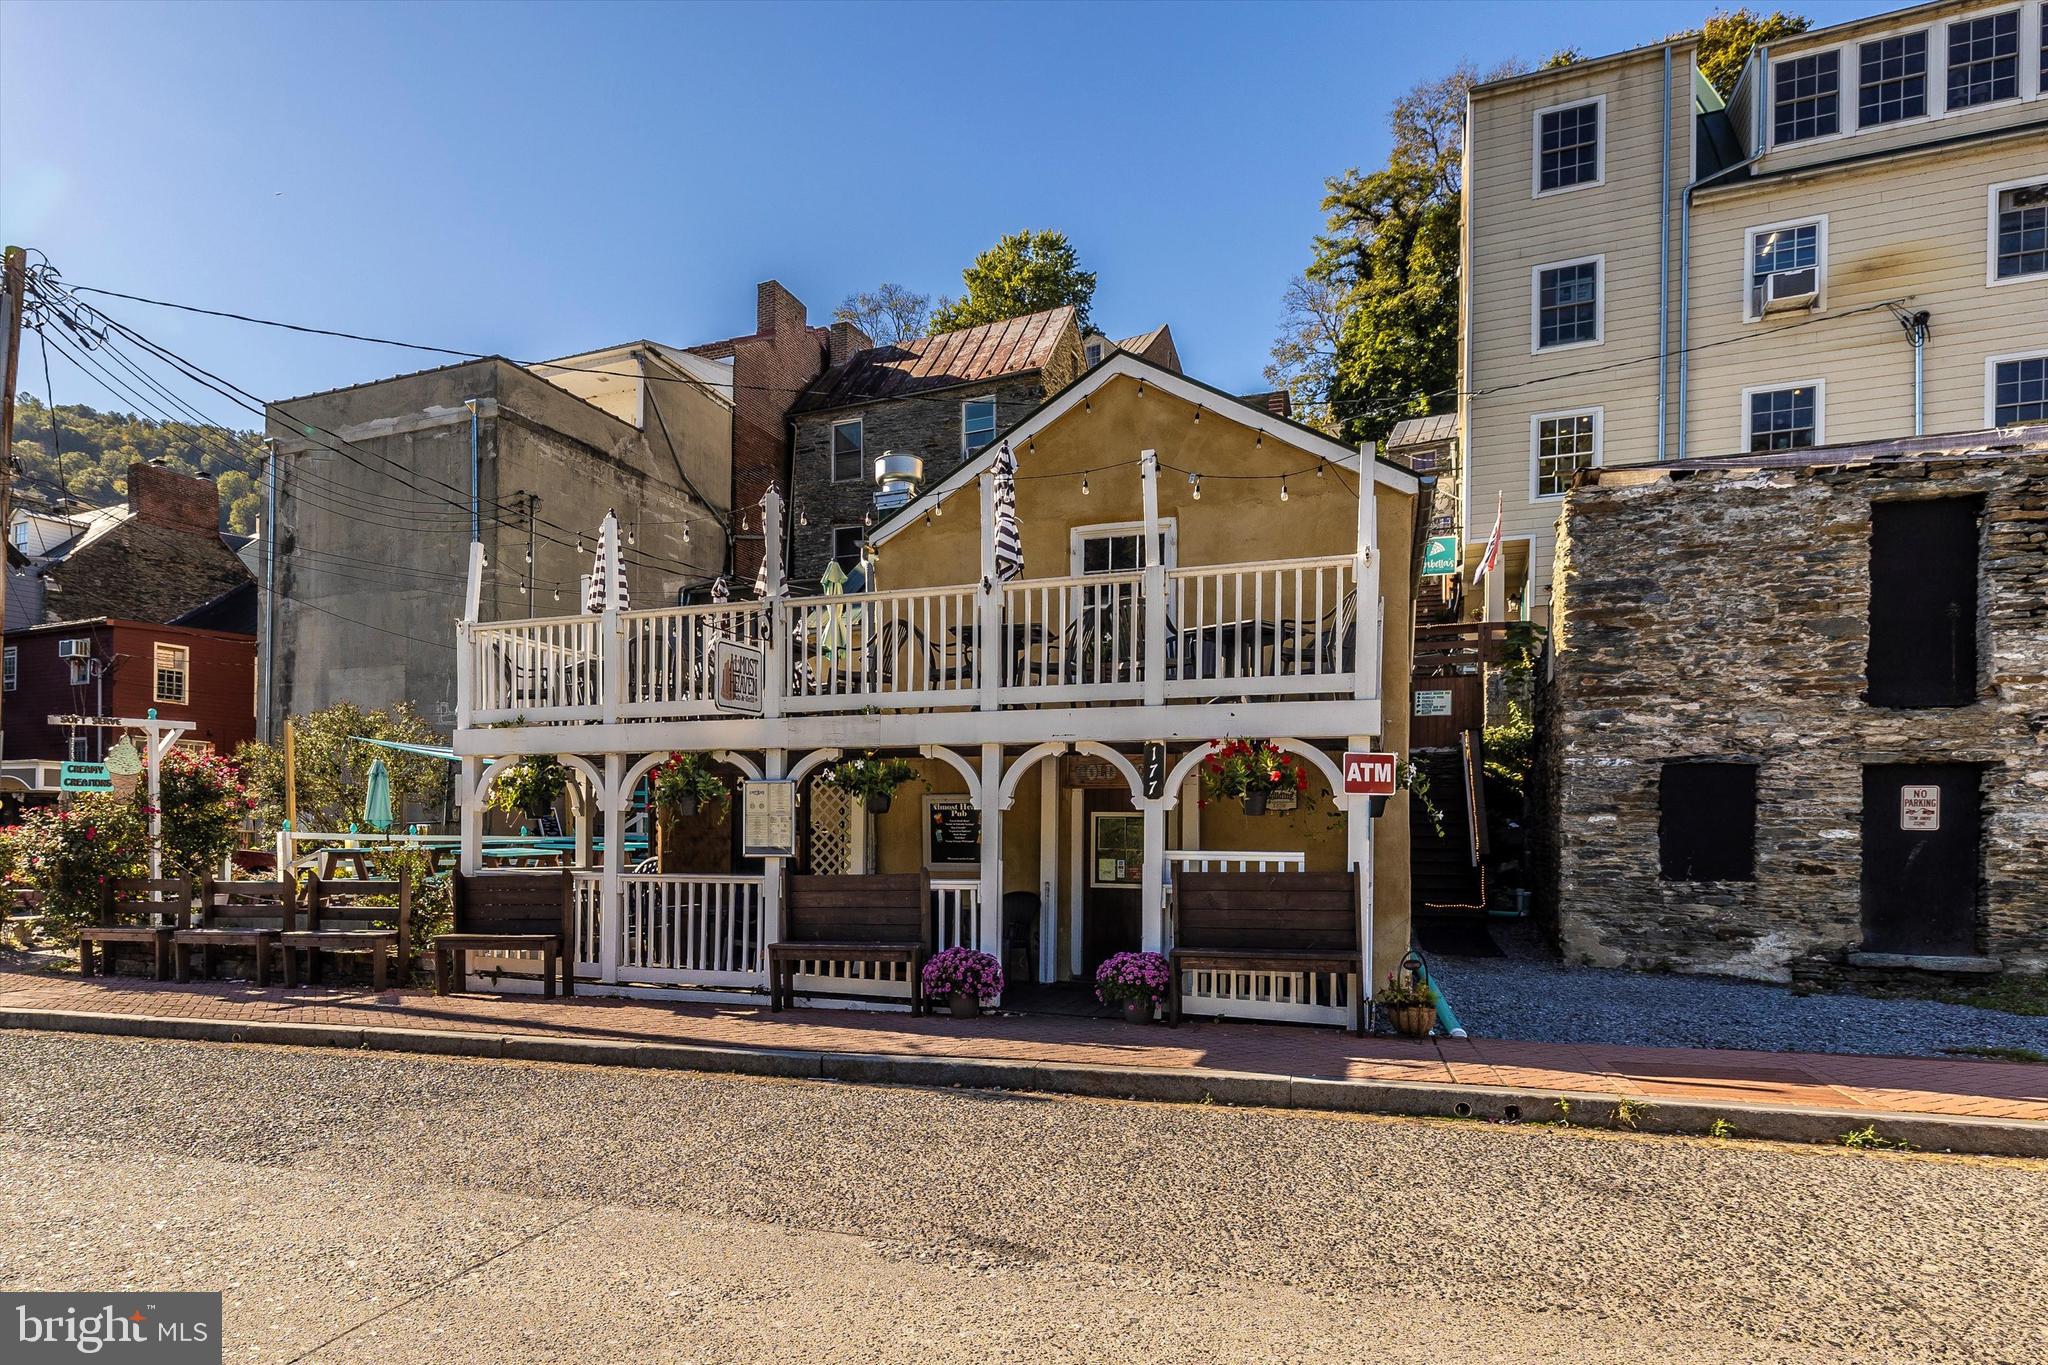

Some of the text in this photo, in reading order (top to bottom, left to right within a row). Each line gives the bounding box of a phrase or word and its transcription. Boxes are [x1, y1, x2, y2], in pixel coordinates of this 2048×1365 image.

[1424, 558, 1455, 569] abella's
[730, 653, 759, 678] ALMOST
[730, 669, 758, 697] HEAVEN
[60, 714, 122, 726] SOFT SERVE
[67, 764, 105, 774] CREAMY
[1149, 746, 1159, 795] 177
[1346, 762, 1391, 782] ATM
[63, 777, 113, 787] CREATIONS
[1914, 790, 1927, 798] NO
[1904, 799, 1936, 807] PARKING
